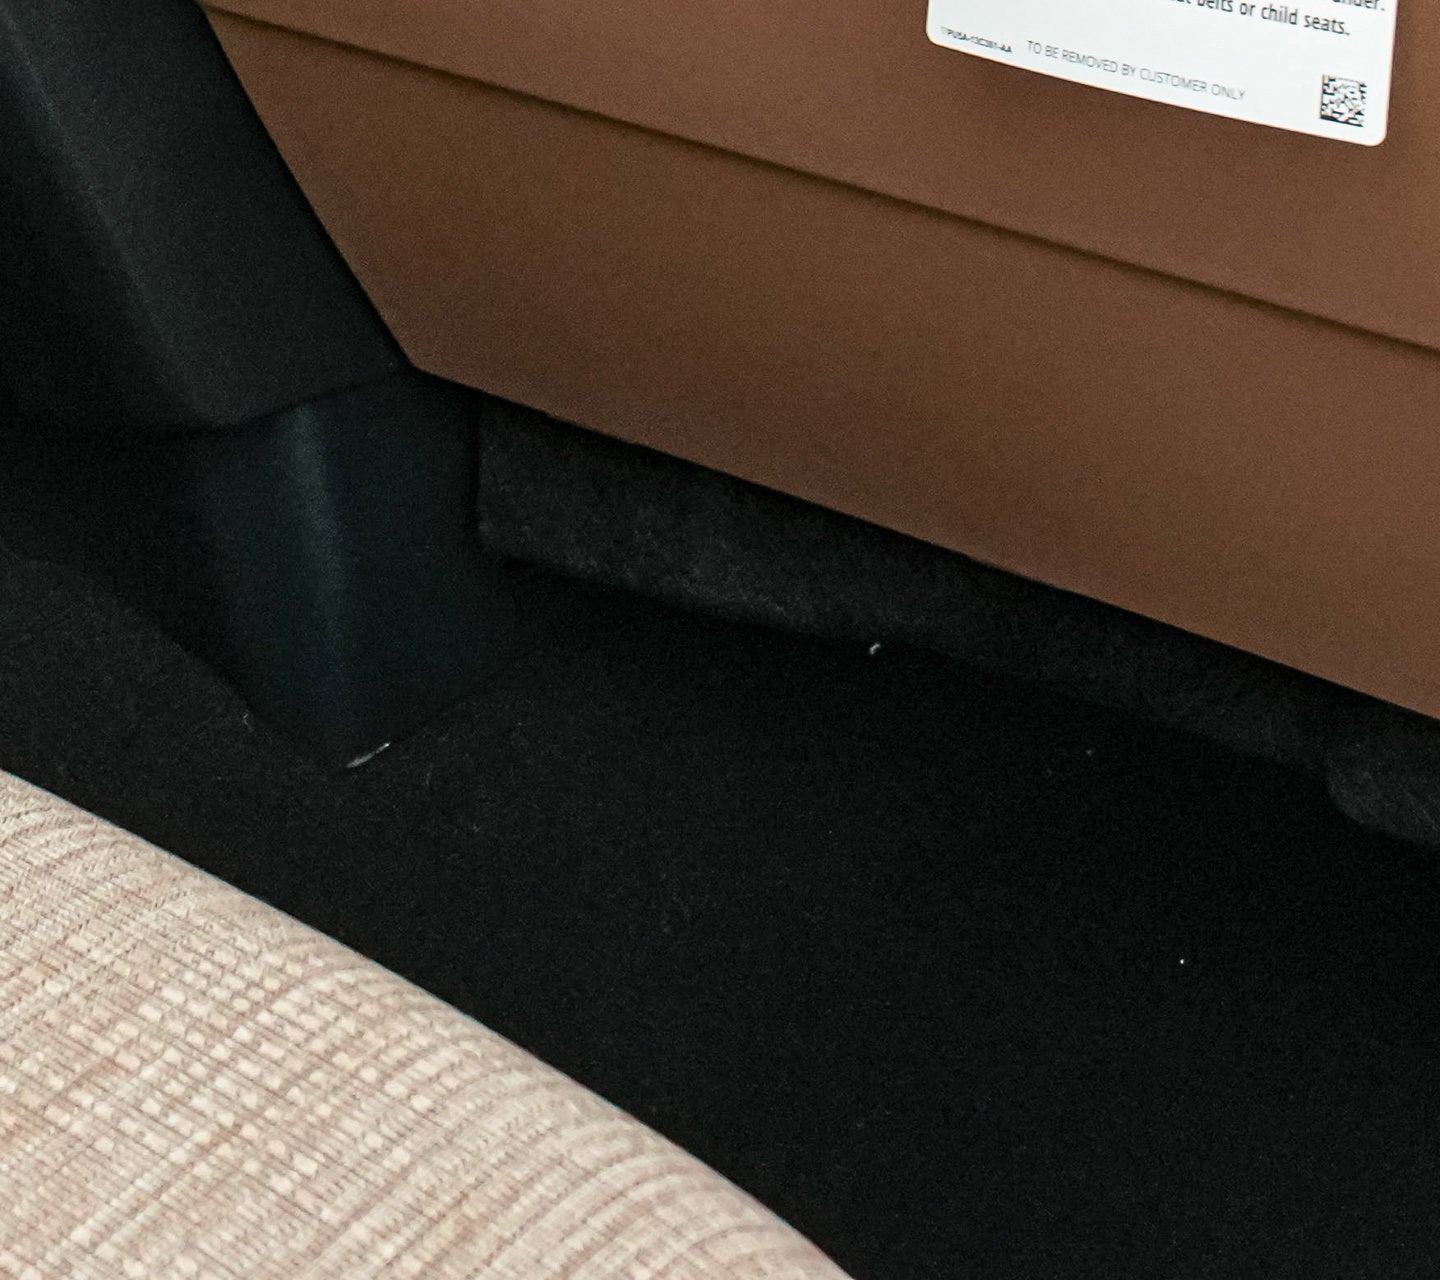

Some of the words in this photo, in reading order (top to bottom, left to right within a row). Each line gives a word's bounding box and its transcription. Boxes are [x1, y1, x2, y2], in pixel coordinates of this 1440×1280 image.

[1239, 1, 1256, 18] or
[1260, 2, 1299, 26] child
[1303, 12, 1351, 37] seats.
[1026, 39, 1043, 55] TO
[1044, 43, 1060, 60] BE
[1061, 50, 1119, 75] REMOVED
[1121, 62, 1138, 78] BY
[1138, 67, 1208, 93] CUSTOMER
[1210, 82, 1248, 102] ONLY
